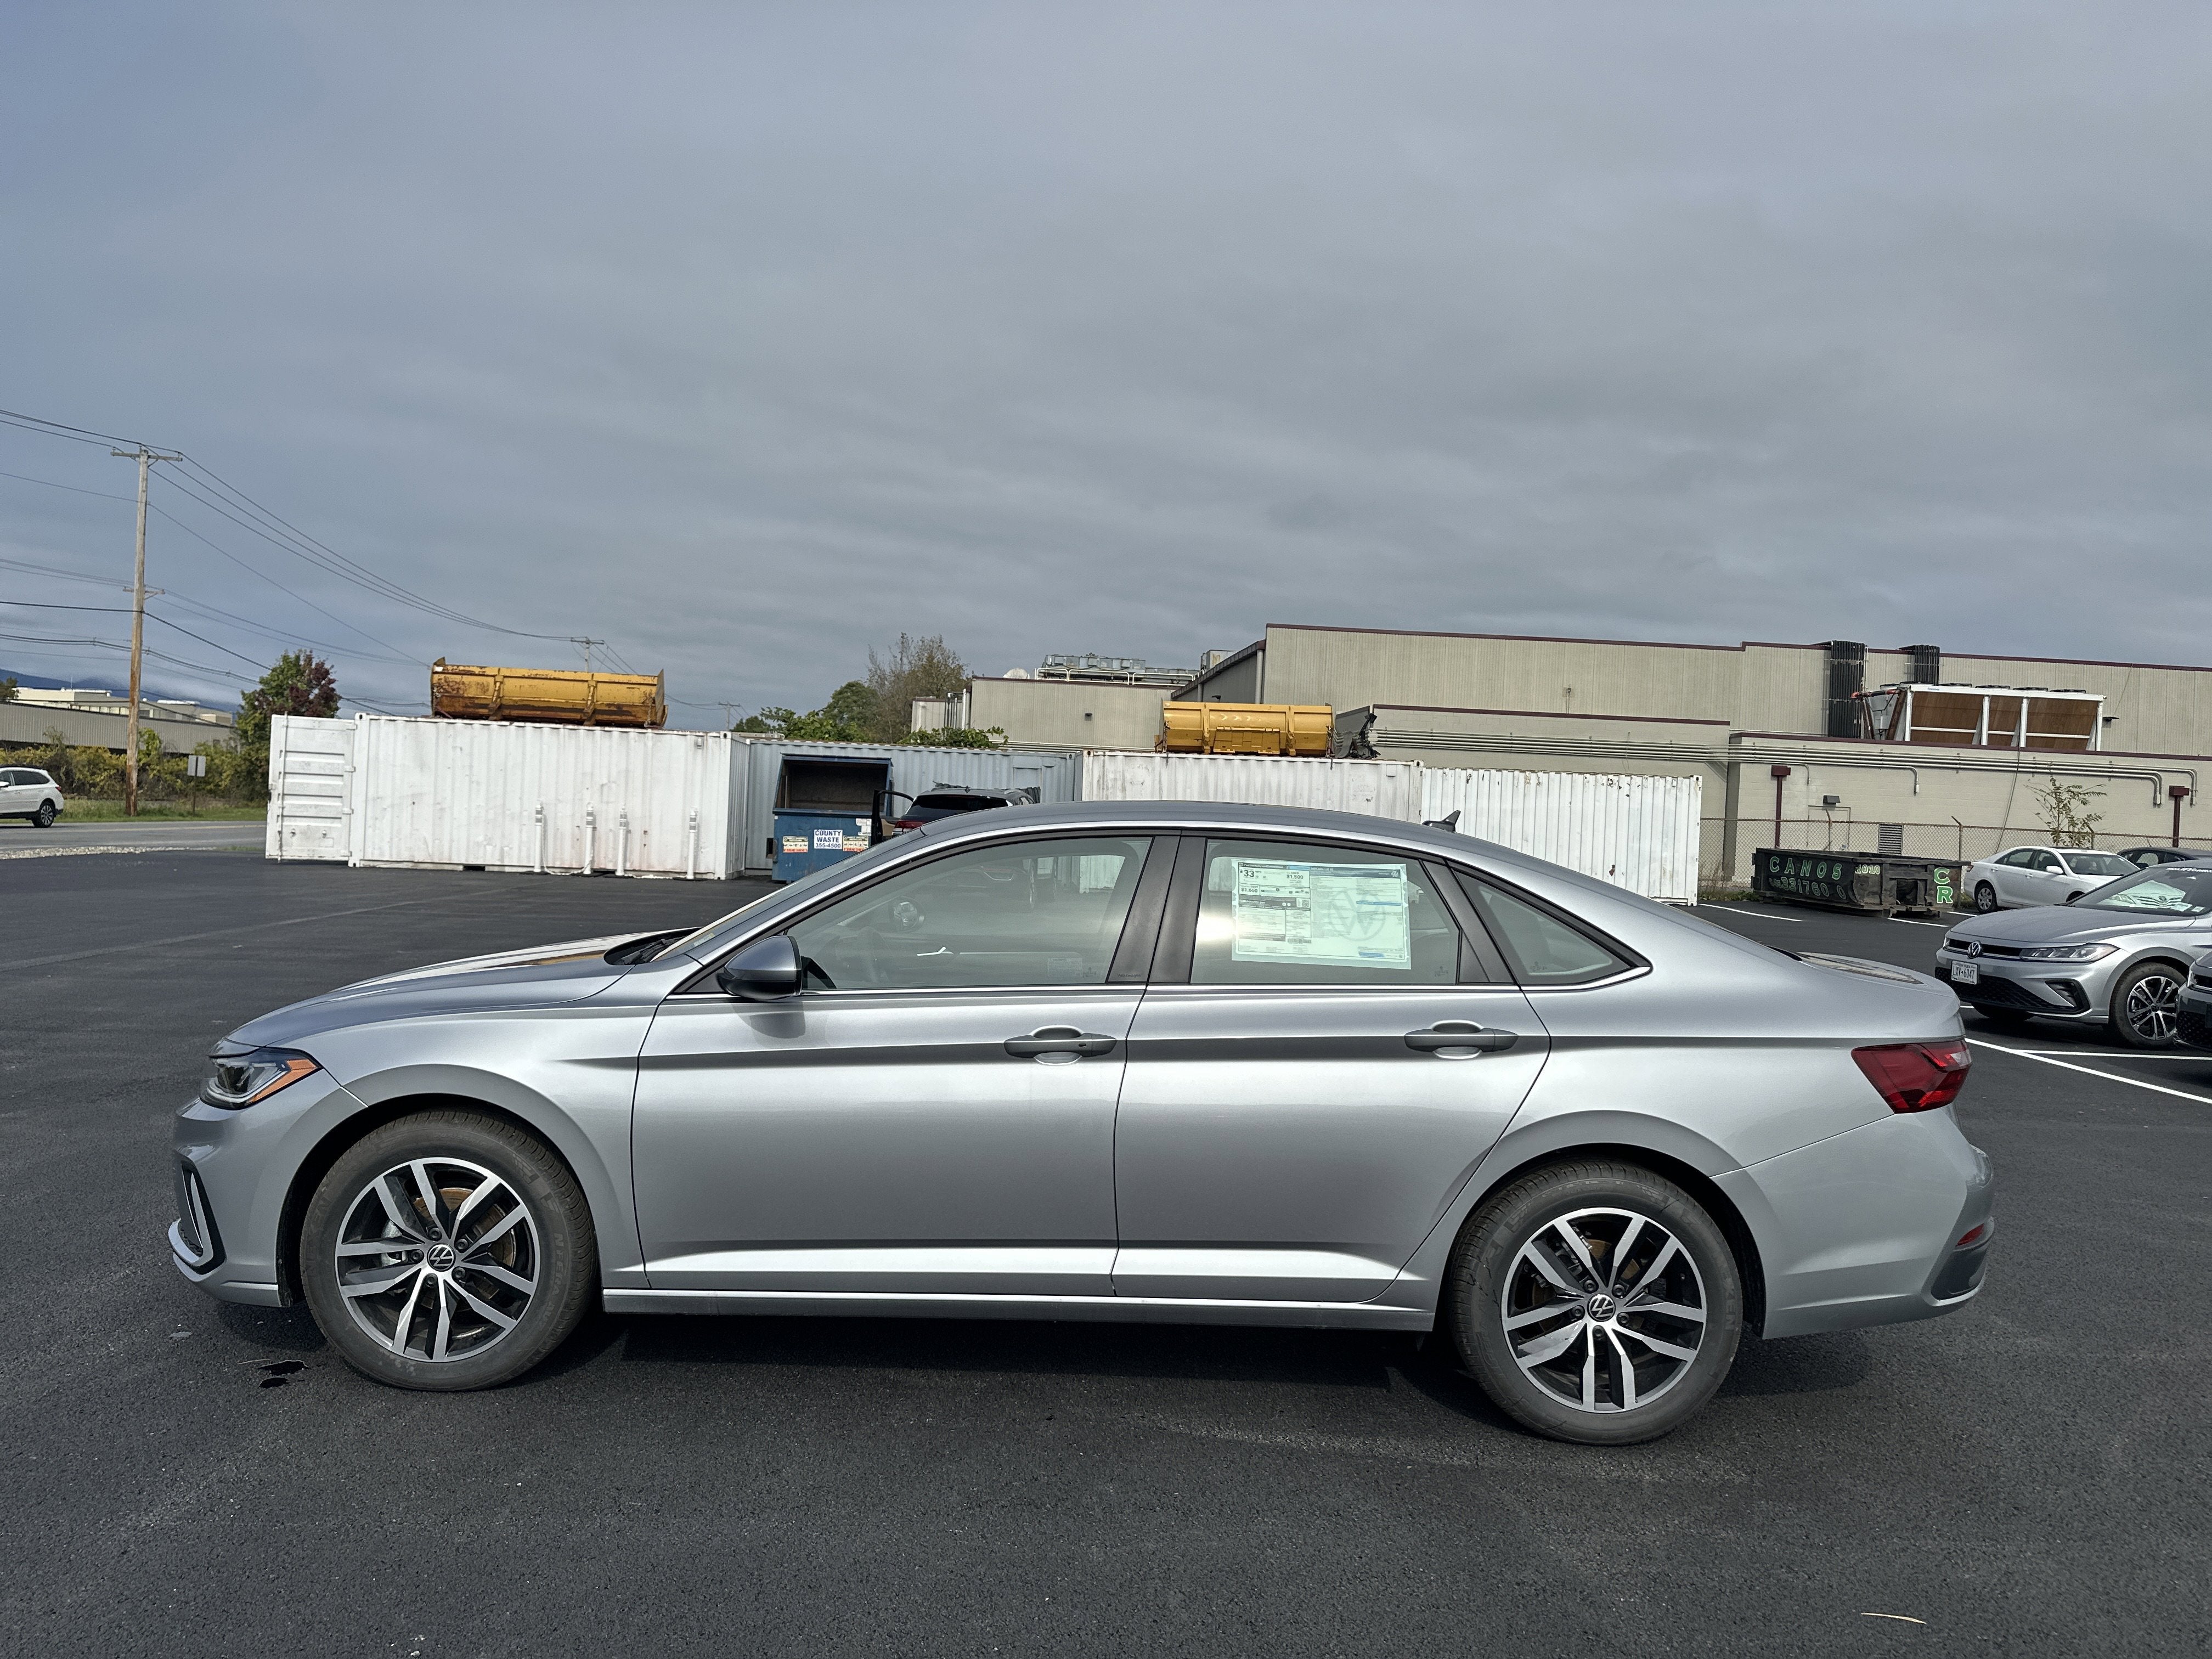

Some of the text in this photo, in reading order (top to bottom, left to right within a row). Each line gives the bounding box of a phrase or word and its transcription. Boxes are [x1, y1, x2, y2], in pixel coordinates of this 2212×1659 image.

[1769, 856, 1843, 880] CANOS
[1854, 864, 1881, 874] 1010
[1243, 870, 1255, 878] 33
